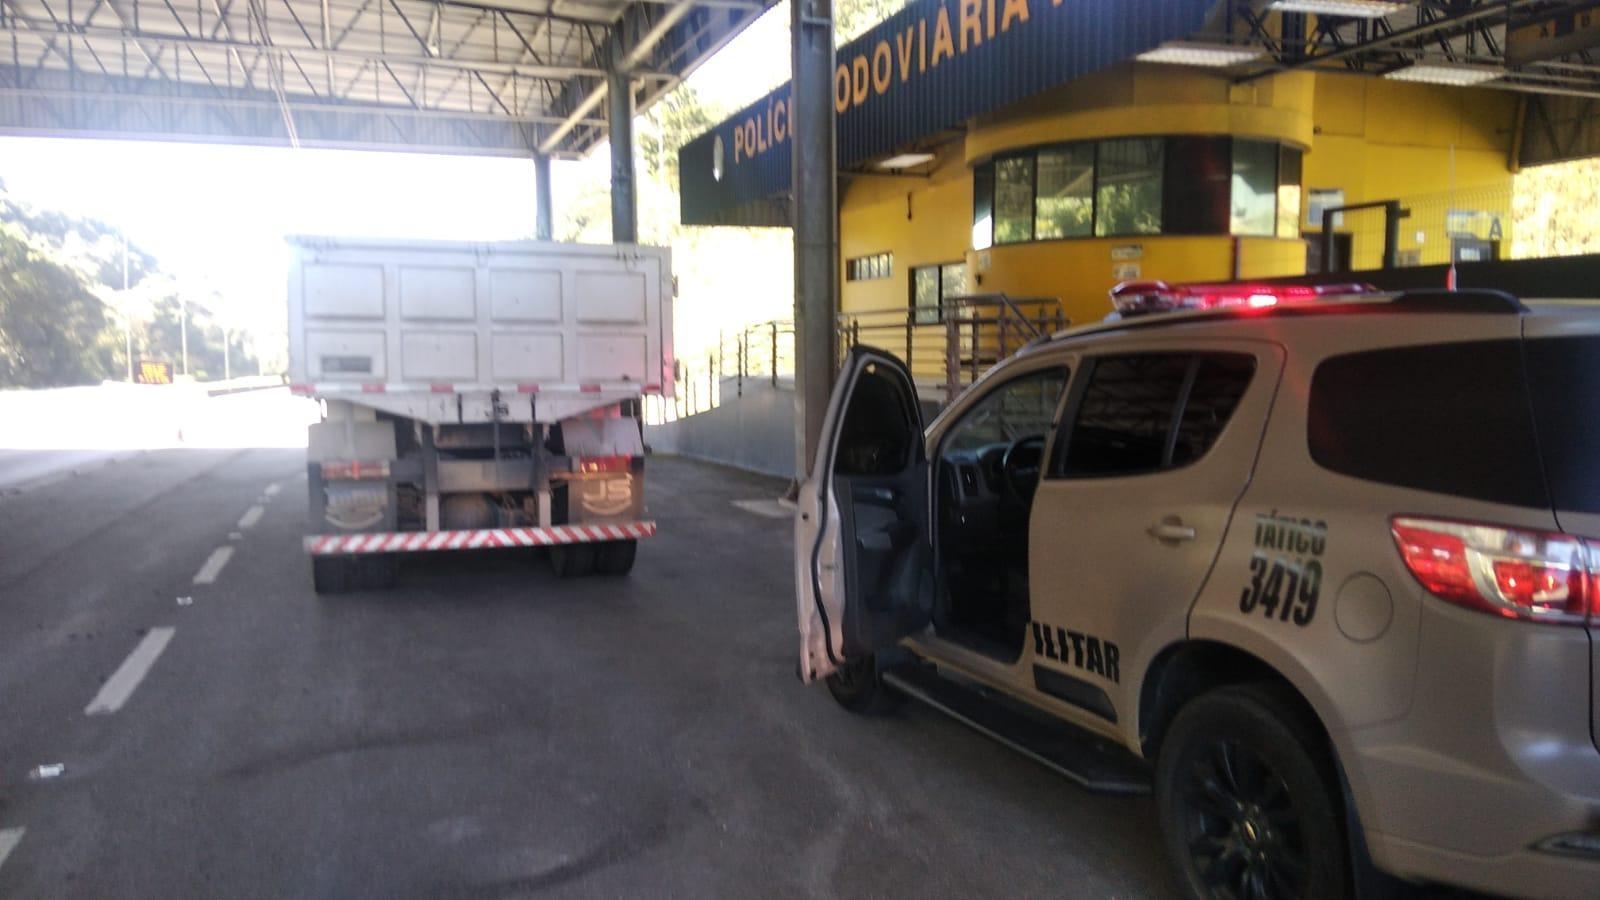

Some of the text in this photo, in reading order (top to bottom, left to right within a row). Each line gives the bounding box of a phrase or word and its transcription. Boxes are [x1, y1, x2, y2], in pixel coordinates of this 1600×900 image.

[735, 0, 1030, 164] POLÍCI ODOVIÁRIA
[1254, 508, 1328, 556] TÁTICO
[1031, 620, 1120, 683] ILITAR
